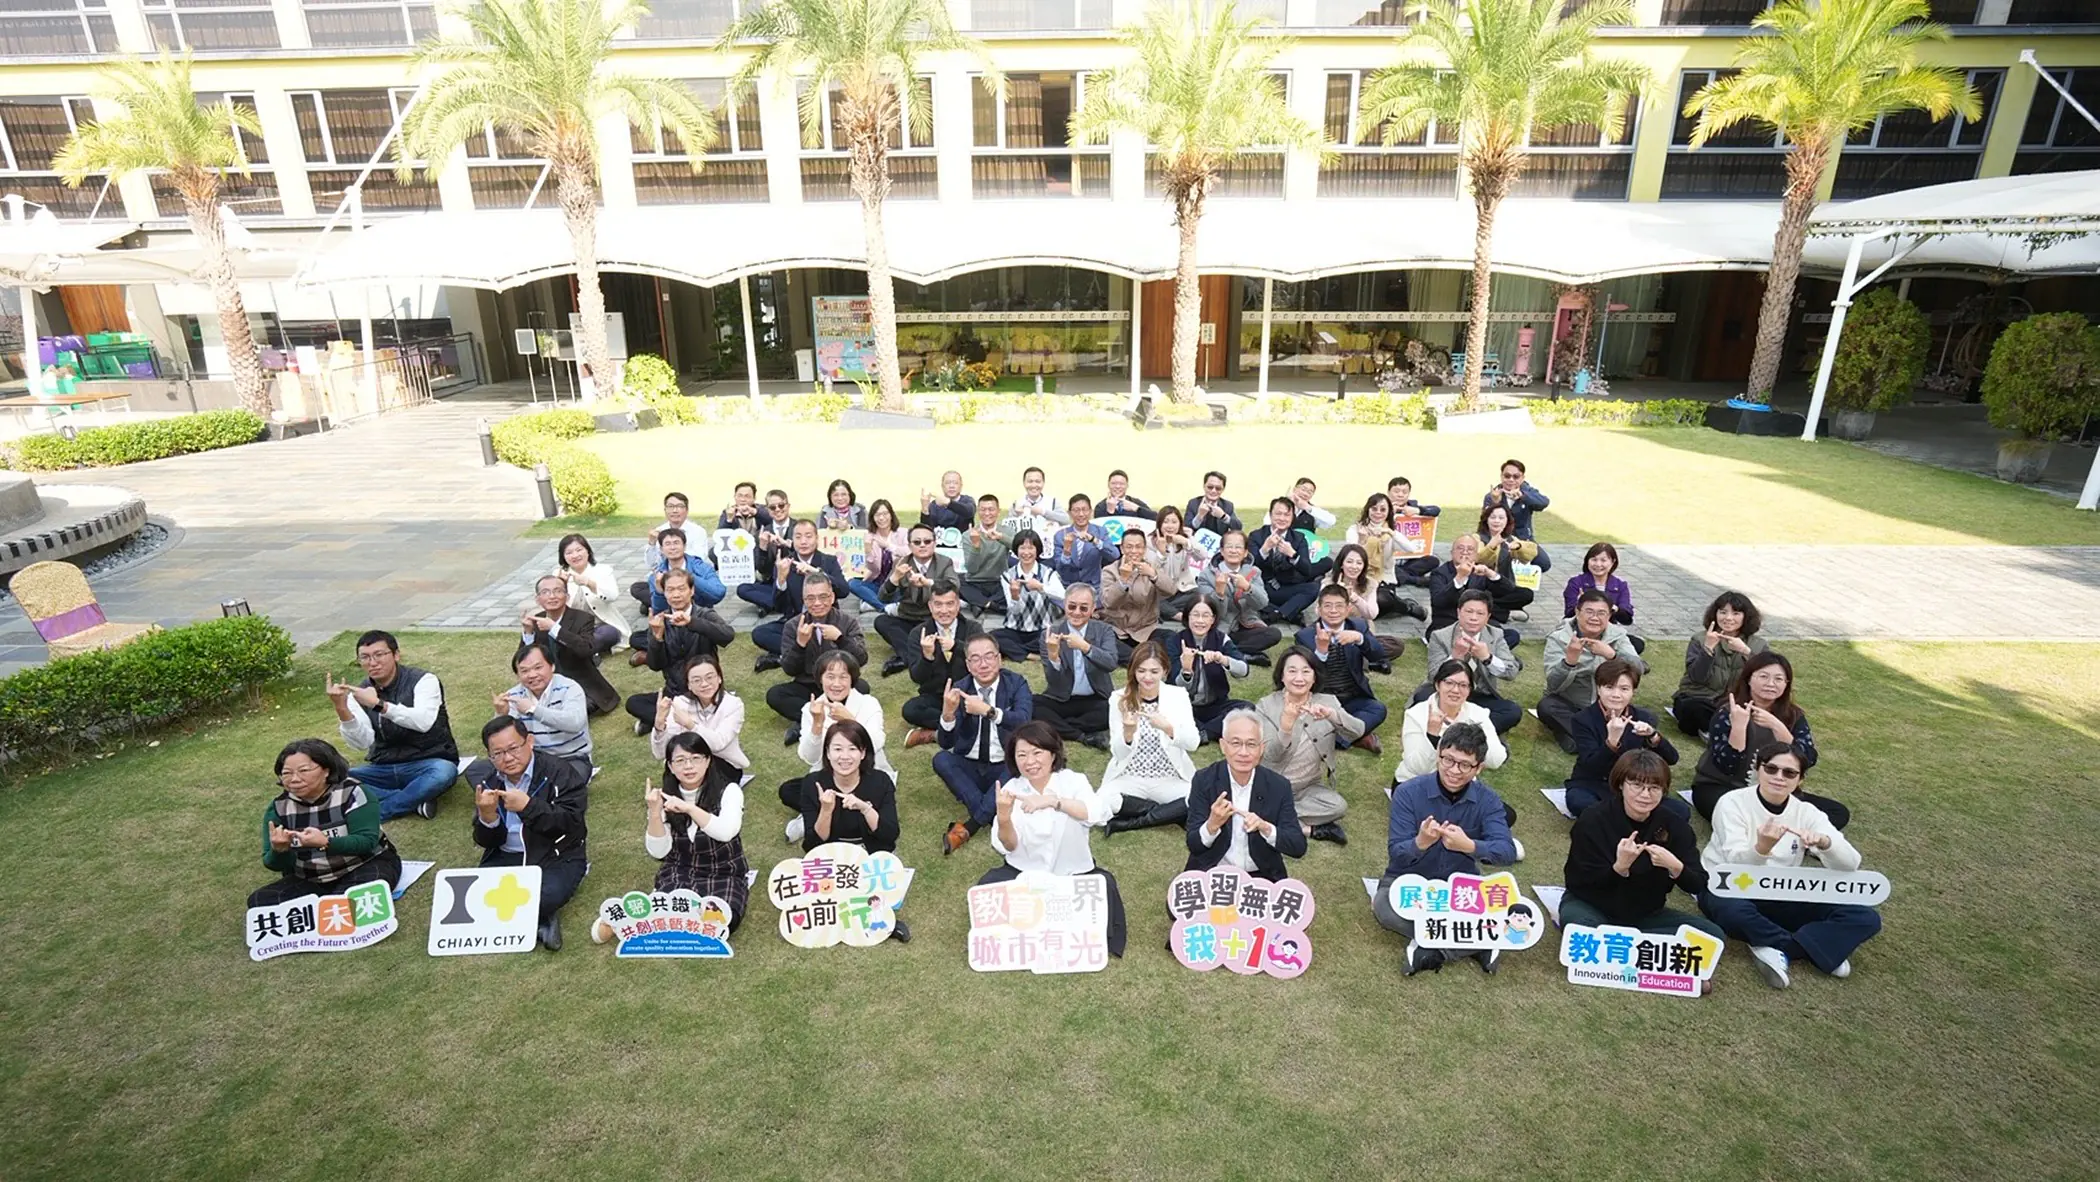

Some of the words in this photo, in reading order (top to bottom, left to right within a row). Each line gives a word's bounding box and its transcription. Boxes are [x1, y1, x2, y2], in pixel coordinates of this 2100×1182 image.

[773, 858, 897, 901] 在嘉發光
[1759, 877, 1827, 892] CHIAYI
[1835, 881, 1881, 895] CITY
[786, 898, 873, 934] 向前行
[1174, 873, 1304, 924] 學習無界
[1400, 884, 1509, 912] 展望教育
[253, 891, 384, 942] 共創未來
[1425, 918, 1499, 943] 新世代
[257, 939, 299, 956] Creating
[300, 936, 316, 947] the
[317, 938, 349, 947] Future
[349, 922, 389, 945] Together
[437, 936, 488, 949] CHIAYI
[493, 935, 526, 946] CITY
[972, 929, 1103, 967] 城市有光
[1184, 927, 1266, 968] 我+1
[1568, 932, 1703, 976] 教育創新
[1574, 968, 1626, 982] Innovation
[1627, 974, 1637, 983] in
[1641, 976, 1692, 990] Education
